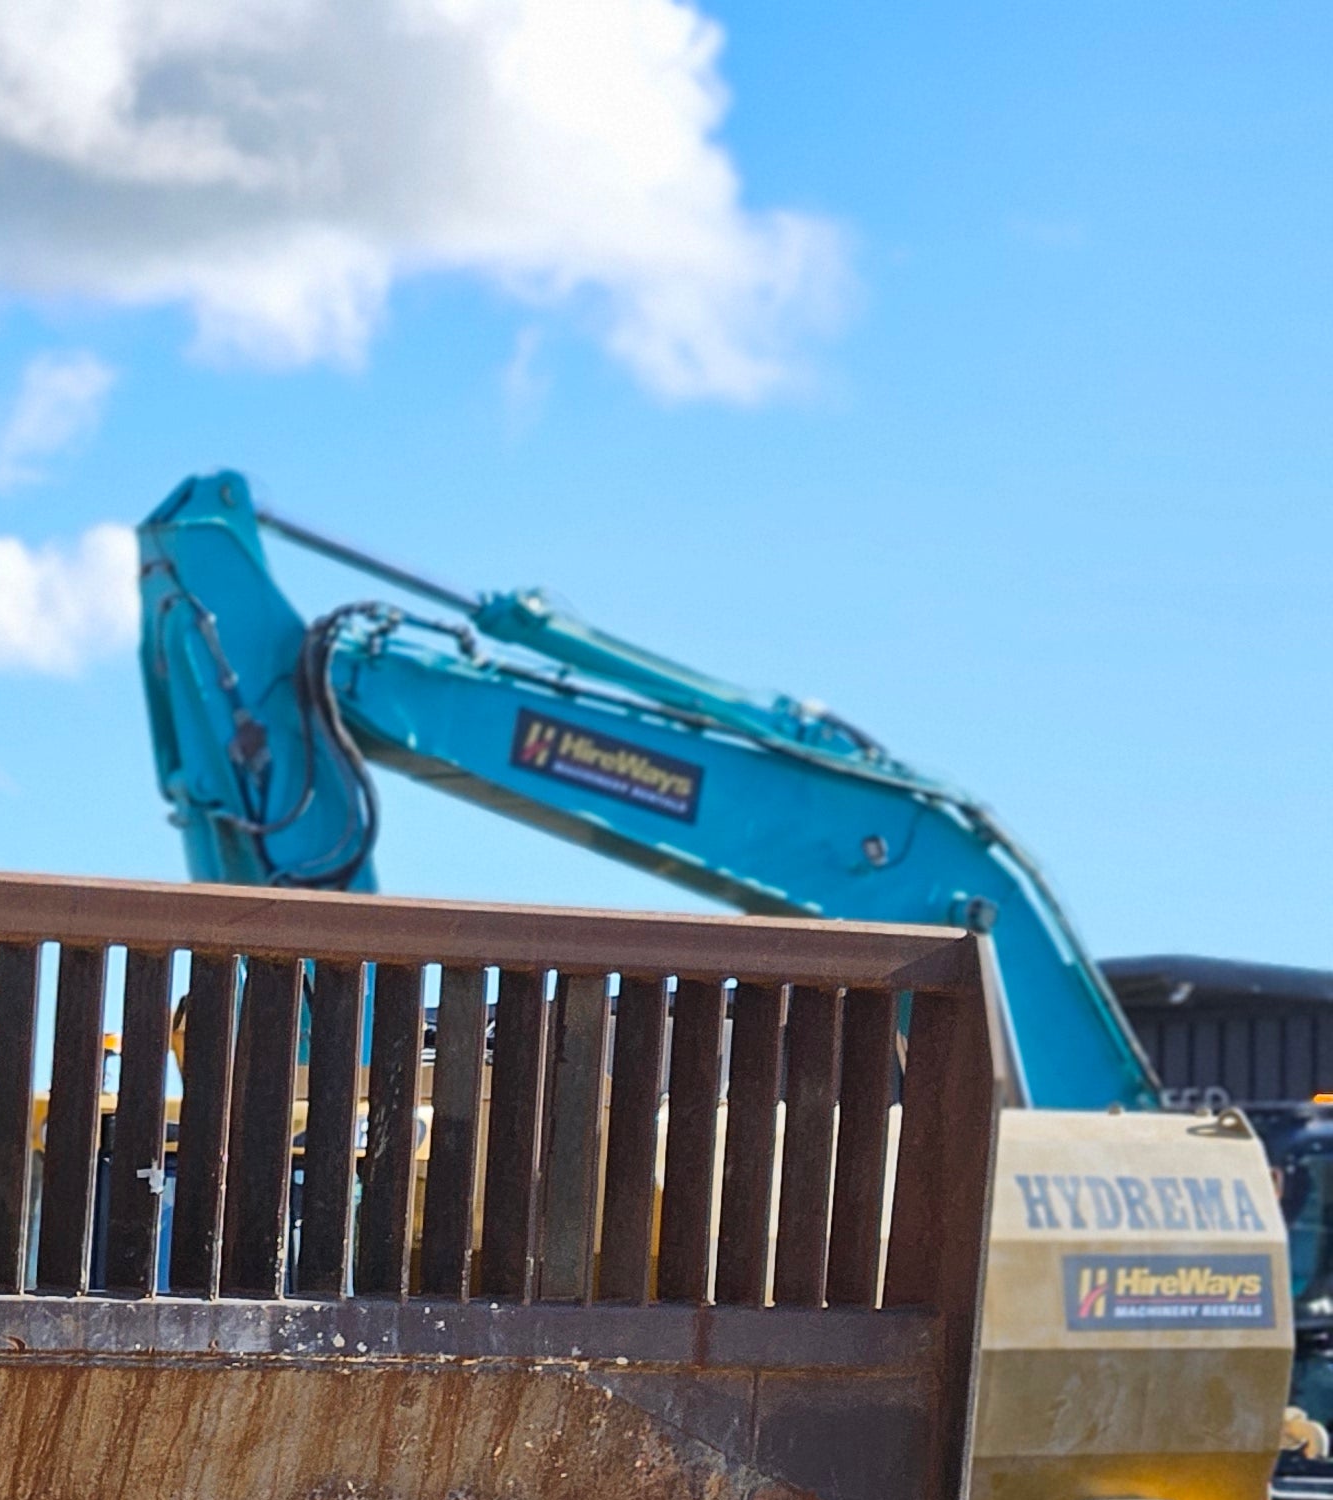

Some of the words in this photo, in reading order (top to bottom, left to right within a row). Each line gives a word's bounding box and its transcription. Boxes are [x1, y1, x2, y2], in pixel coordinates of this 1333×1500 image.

[558, 731, 693, 797] HireWays
[1014, 1174, 1266, 1232] HYDREMA
[1114, 1266, 1263, 1303] HireWays
[1113, 1304, 1199, 1319] MACHINERY
[1201, 1303, 1264, 1318] RENTALS
